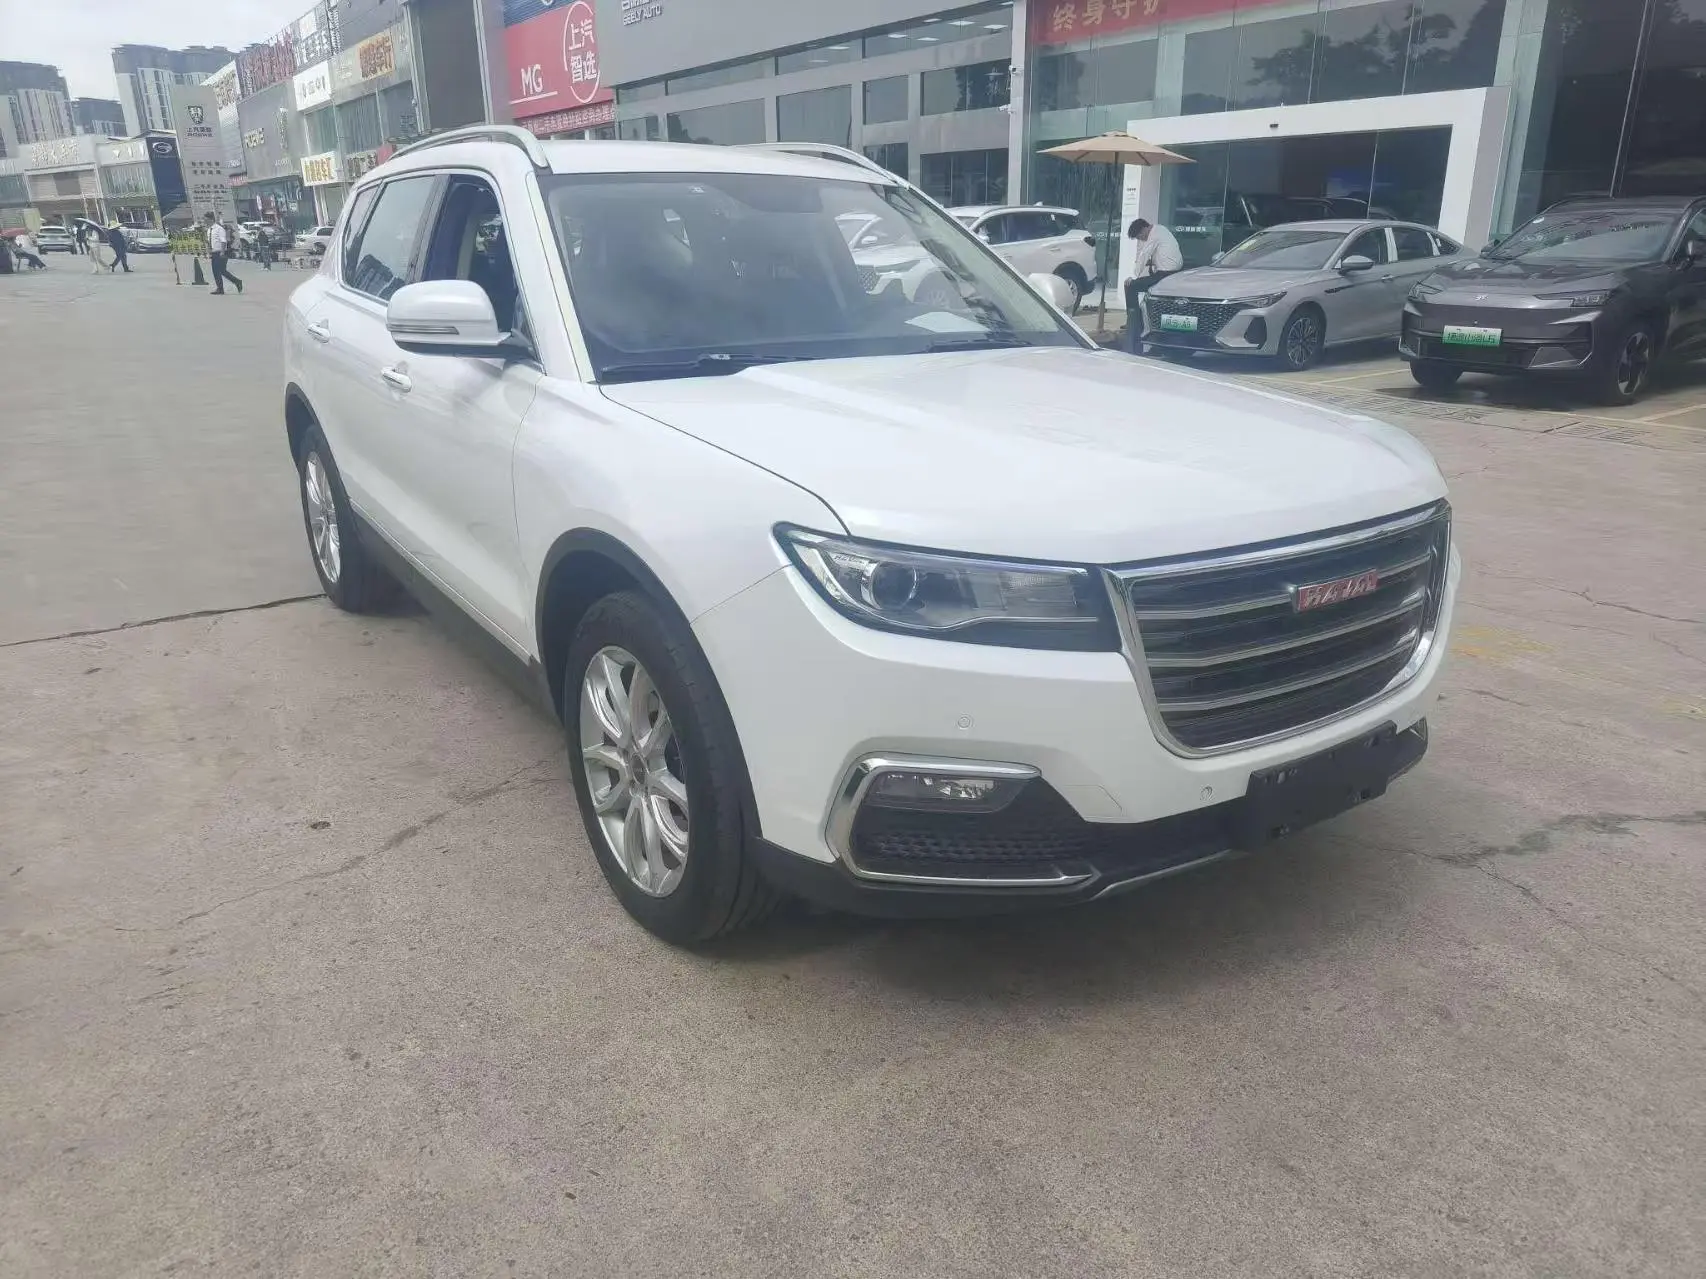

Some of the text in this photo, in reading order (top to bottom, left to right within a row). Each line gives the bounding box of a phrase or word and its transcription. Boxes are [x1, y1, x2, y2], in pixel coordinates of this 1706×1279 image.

[643, 4, 661, 18] AUTO
[568, 18, 596, 51] 上汽
[520, 64, 544, 95] MG
[570, 51, 597, 83] 智选
